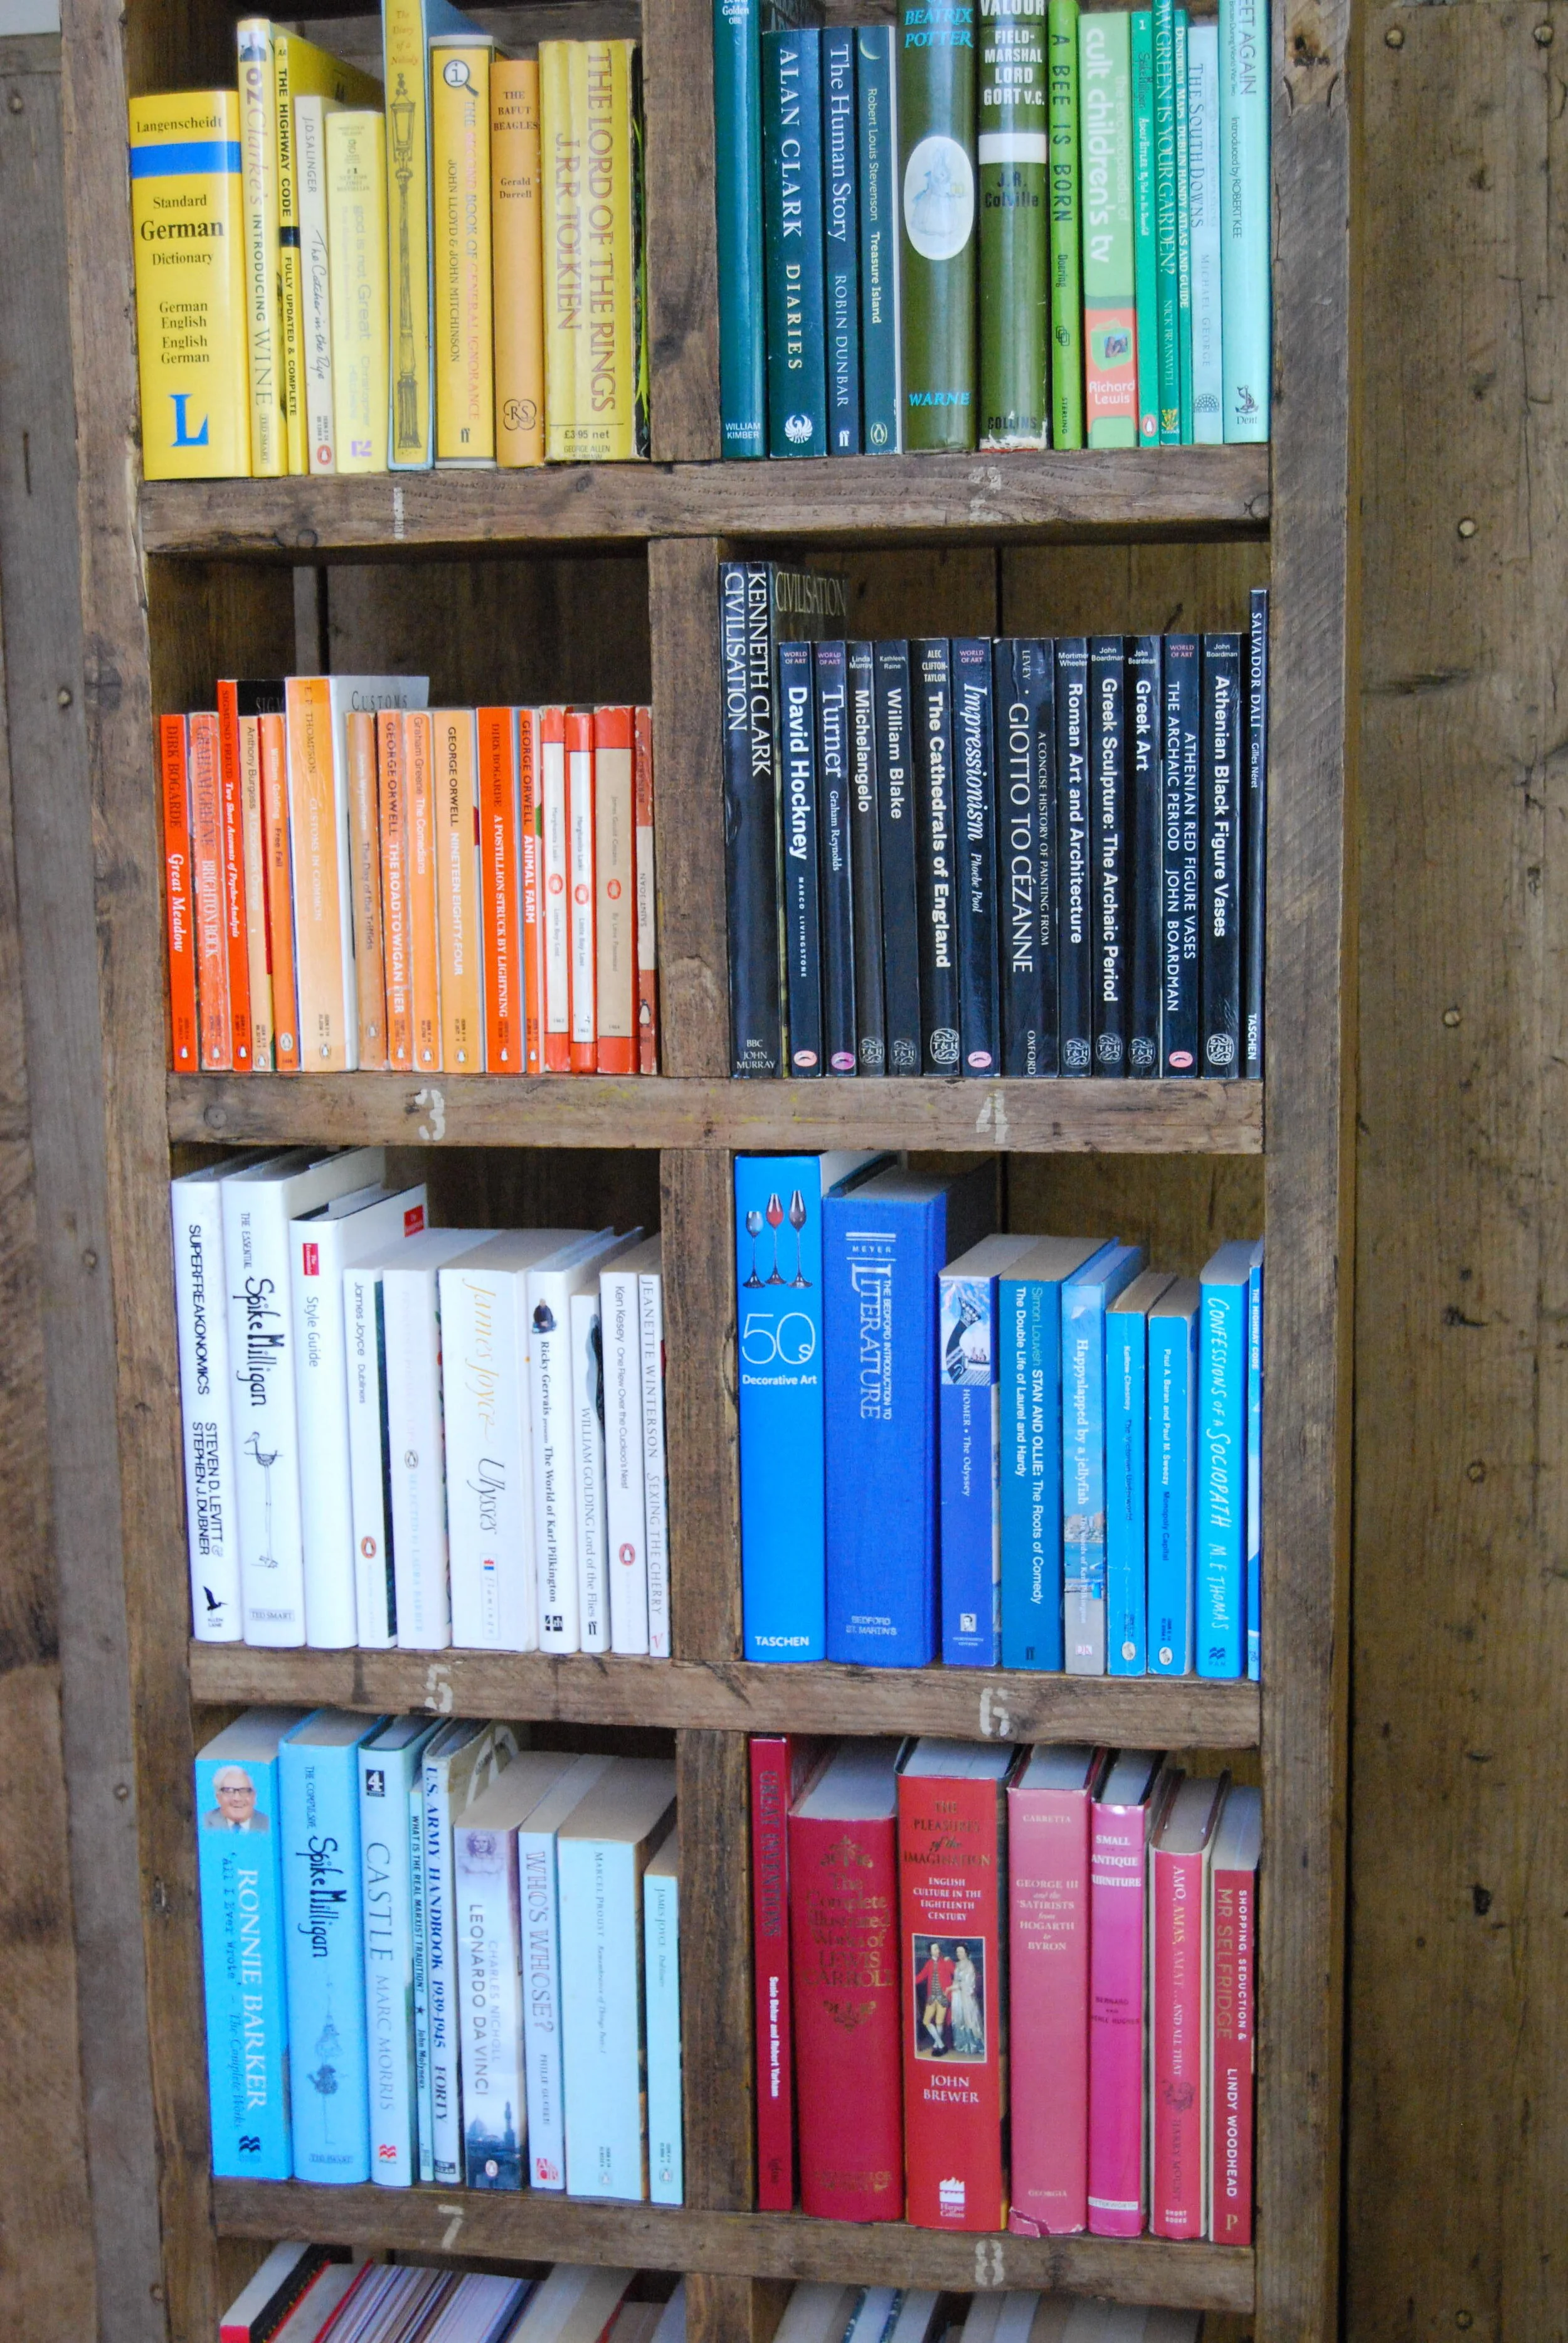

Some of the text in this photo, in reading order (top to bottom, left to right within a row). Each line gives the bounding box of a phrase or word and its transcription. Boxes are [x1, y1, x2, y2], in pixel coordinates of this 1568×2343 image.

[904, 8, 973, 25] BEATRIX
[904, 31, 973, 48] POTTER
[984, 48, 1043, 63] MARSHAL
[995, 30, 1034, 45] FIELD-
[983, 89, 1021, 105] GORT
[995, 67, 1034, 83] LORD
[136, 117, 223, 134] Langenscheidt
[278, 68, 291, 217] THE HIGHWAY CODE
[780, 48, 802, 238] ALAN CLARK
[828, 44, 851, 242] The Human Story
[867, 88, 879, 221] Robert Louis Stevenson
[1052, 35, 1073, 221] A BEE IS BORN
[1085, 31, 1115, 263] cult children's tv
[140, 220, 225, 241] German
[152, 194, 208, 209] Standard
[588, 49, 615, 412] THE LORD OF THE RINGS
[152, 253, 213, 266] Dictionary
[284, 257, 294, 289] FULLY
[870, 231, 882, 323] Treasure Island
[159, 301, 208, 312] German
[161, 317, 207, 329] English
[162, 336, 208, 347] English
[252, 214, 273, 406] INTRODUCING WINE
[285, 294, 295, 342] UPDATED
[786, 264, 802, 370] DIARIES
[835, 275, 848, 407] ROBIN DUNBAR
[161, 353, 210, 363] German
[288, 361, 297, 416] COMPLETE
[909, 391, 971, 406] WARNE
[1089, 380, 1135, 393] Richard
[168, 393, 209, 447] L
[725, 422, 761, 431] WILLIAM
[726, 431, 760, 439] KIMBER
[1094, 393, 1130, 405] Lewis
[724, 572, 747, 731] CIVILISATION
[748, 571, 771, 776] KENNETH CLARK
[1250, 612, 1264, 728] SALVADOR DALÍ
[821, 686, 844, 778] Turner
[852, 689, 872, 812] Michelangelo
[887, 688, 904, 819] William Blake
[960, 684, 987, 841] Impressionism
[1135, 680, 1151, 771] Greek Art
[522, 721, 532, 825] GEORGE ORWELL
[788, 686, 811, 860] David Hockney
[828, 790, 842, 871] Graham Reynolds
[928, 692, 950, 968] The Cathedrals of England
[1008, 703, 1036, 972] GIOTTO TO CÉZANNE
[1100, 679, 1118, 1001] Greek Sculpture: The Archaic Period
[170, 854, 186, 952] Great Meadow
[524, 836, 535, 923] ANIMAL FARM
[970, 853, 983, 911] Phoebe Pool
[1247, 1013, 1258, 1060] TASCHEN
[416, 1088, 446, 1140] 3
[976, 1090, 1008, 1144] 4
[188, 1225, 209, 1395] SUPERFREAKONOMICS
[304, 1297, 320, 1367] Style Guide
[742, 1312, 816, 1365] 50s
[539, 1341, 552, 1416] Ricky Gervais
[743, 1375, 817, 1385] Decorative Art
[1013, 1287, 1027, 1476] The Double Life of Laurel and Hardy
[192, 1422, 209, 1555] STEPHEN J. DUBNER
[204, 1423, 222, 1542] STEVEN D. LEVITT
[544, 1446, 558, 1602] The World of Karl Pilkington
[755, 1637, 810, 1646] TASCHEN
[424, 1664, 453, 1713] 5
[980, 1687, 1010, 1737] 6
[366, 1844, 394, 1960] CASTLE
[426, 1767, 447, 2123] U.S. ARMY HANDBOOK 1939-1945 FORTY
[1236, 1890, 1247, 2041] SHOPPING, SEDUCTION &
[237, 1869, 267, 2109] RONNIE BARKER
[469, 1905, 489, 2096] LEONARDO DA VINCI
[769, 1977, 780, 2097] Susie Behar and Robert Yarham
[923, 2090, 979, 2103] BREWER
[931, 2076, 970, 2087] JOHN
[1226, 2068, 1238, 2196] LINDY WOODHEAD
[438, 2204, 465, 2250] 7
[975, 2239, 1005, 2286] 8
